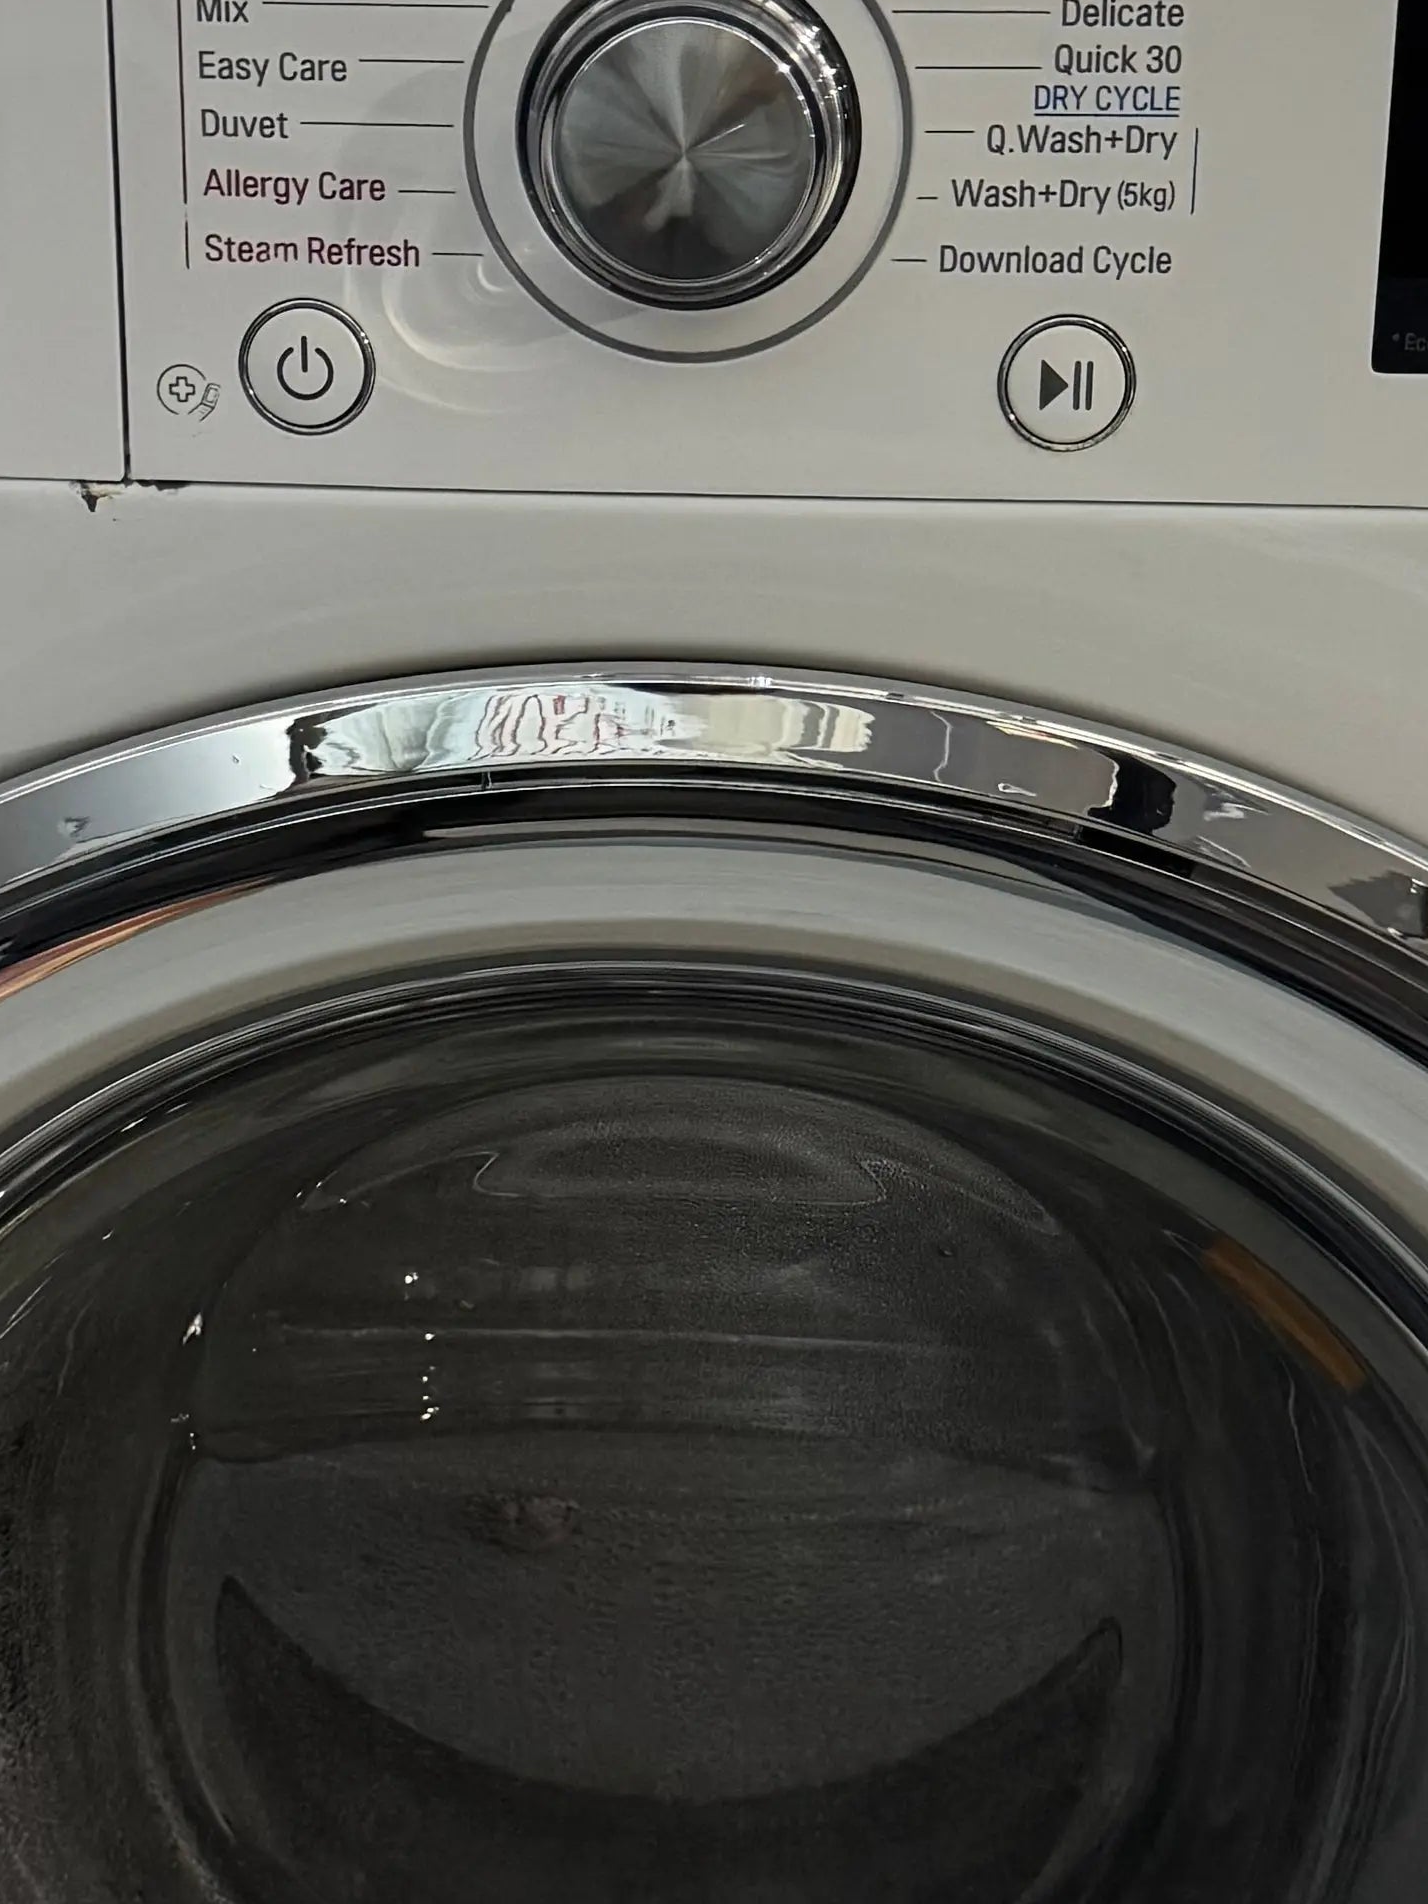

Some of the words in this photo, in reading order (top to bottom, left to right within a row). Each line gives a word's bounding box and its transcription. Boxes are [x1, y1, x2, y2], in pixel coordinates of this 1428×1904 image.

[199, 52, 269, 86] Easy
[279, 53, 347, 81] Care
[1054, 45, 1137, 74] Quick
[1146, 46, 1181, 74] 30
[1035, 86, 1086, 111] DRY
[1096, 86, 1180, 112] CYCLE
[202, 109, 288, 139] Duvet
[987, 125, 1177, 160] Q.Wash+Dry
[203, 170, 308, 205] Allergy
[318, 173, 386, 201] Care
[952, 180, 1110, 215] Wash+Dry
[1118, 181, 1175, 212] (5kg)
[205, 235, 298, 263] Steam
[307, 237, 420, 267] Refresh
[939, 246, 1083, 273] Download
[1092, 247, 1172, 280] Cycle
